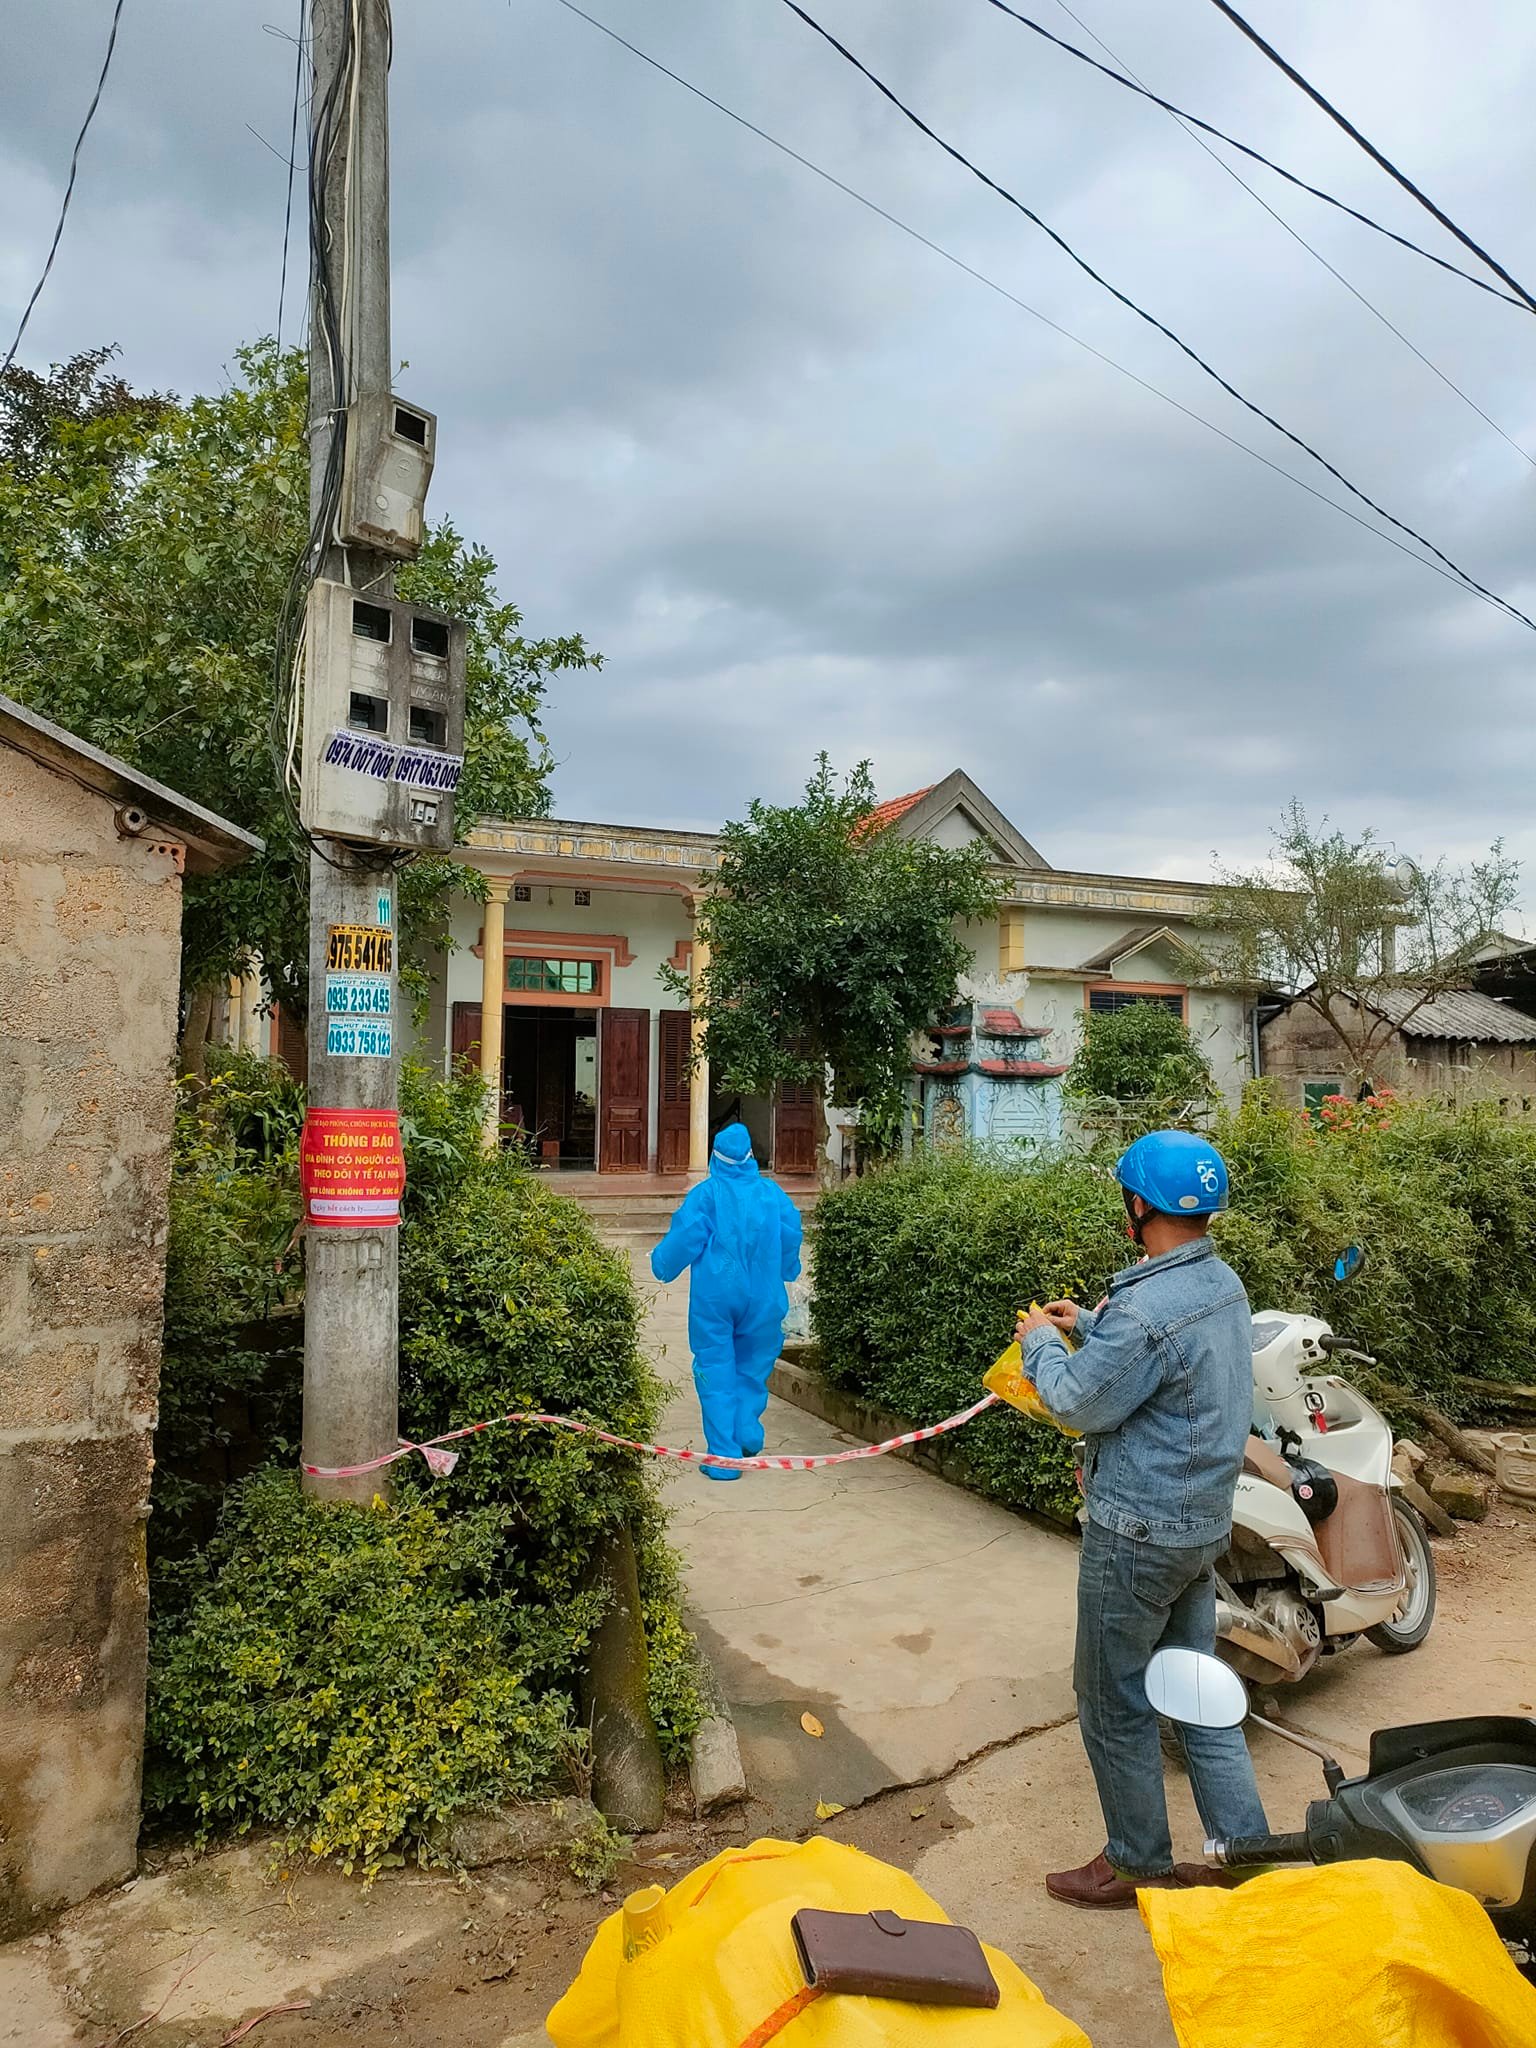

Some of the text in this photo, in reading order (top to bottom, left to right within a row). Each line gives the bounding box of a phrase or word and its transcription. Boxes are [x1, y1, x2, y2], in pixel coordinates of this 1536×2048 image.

[325, 739, 395, 779] 0974.007.008
[395, 755, 461, 790] 0917.063.009
[325, 934, 392, 973] 975.541.415
[328, 1030, 391, 1055] 0933.758.123
[323, 1132, 394, 1148] THÔNG BÁO
[315, 1152, 335, 1165] ĐÌNH
[336, 1153, 353, 1165] CÓ
[355, 1153, 384, 1165] NGƯỜI
[314, 1168, 332, 1179] THEO
[333, 1168, 352, 1179] DÕI
[354, 1170, 360, 1179] Y
[362, 1167, 374, 1179] TẾ
[373, 1170, 386, 1181] TẠI
[1197, 1165, 1218, 1193] 25
[336, 1186, 364, 1196] KHÔNG
